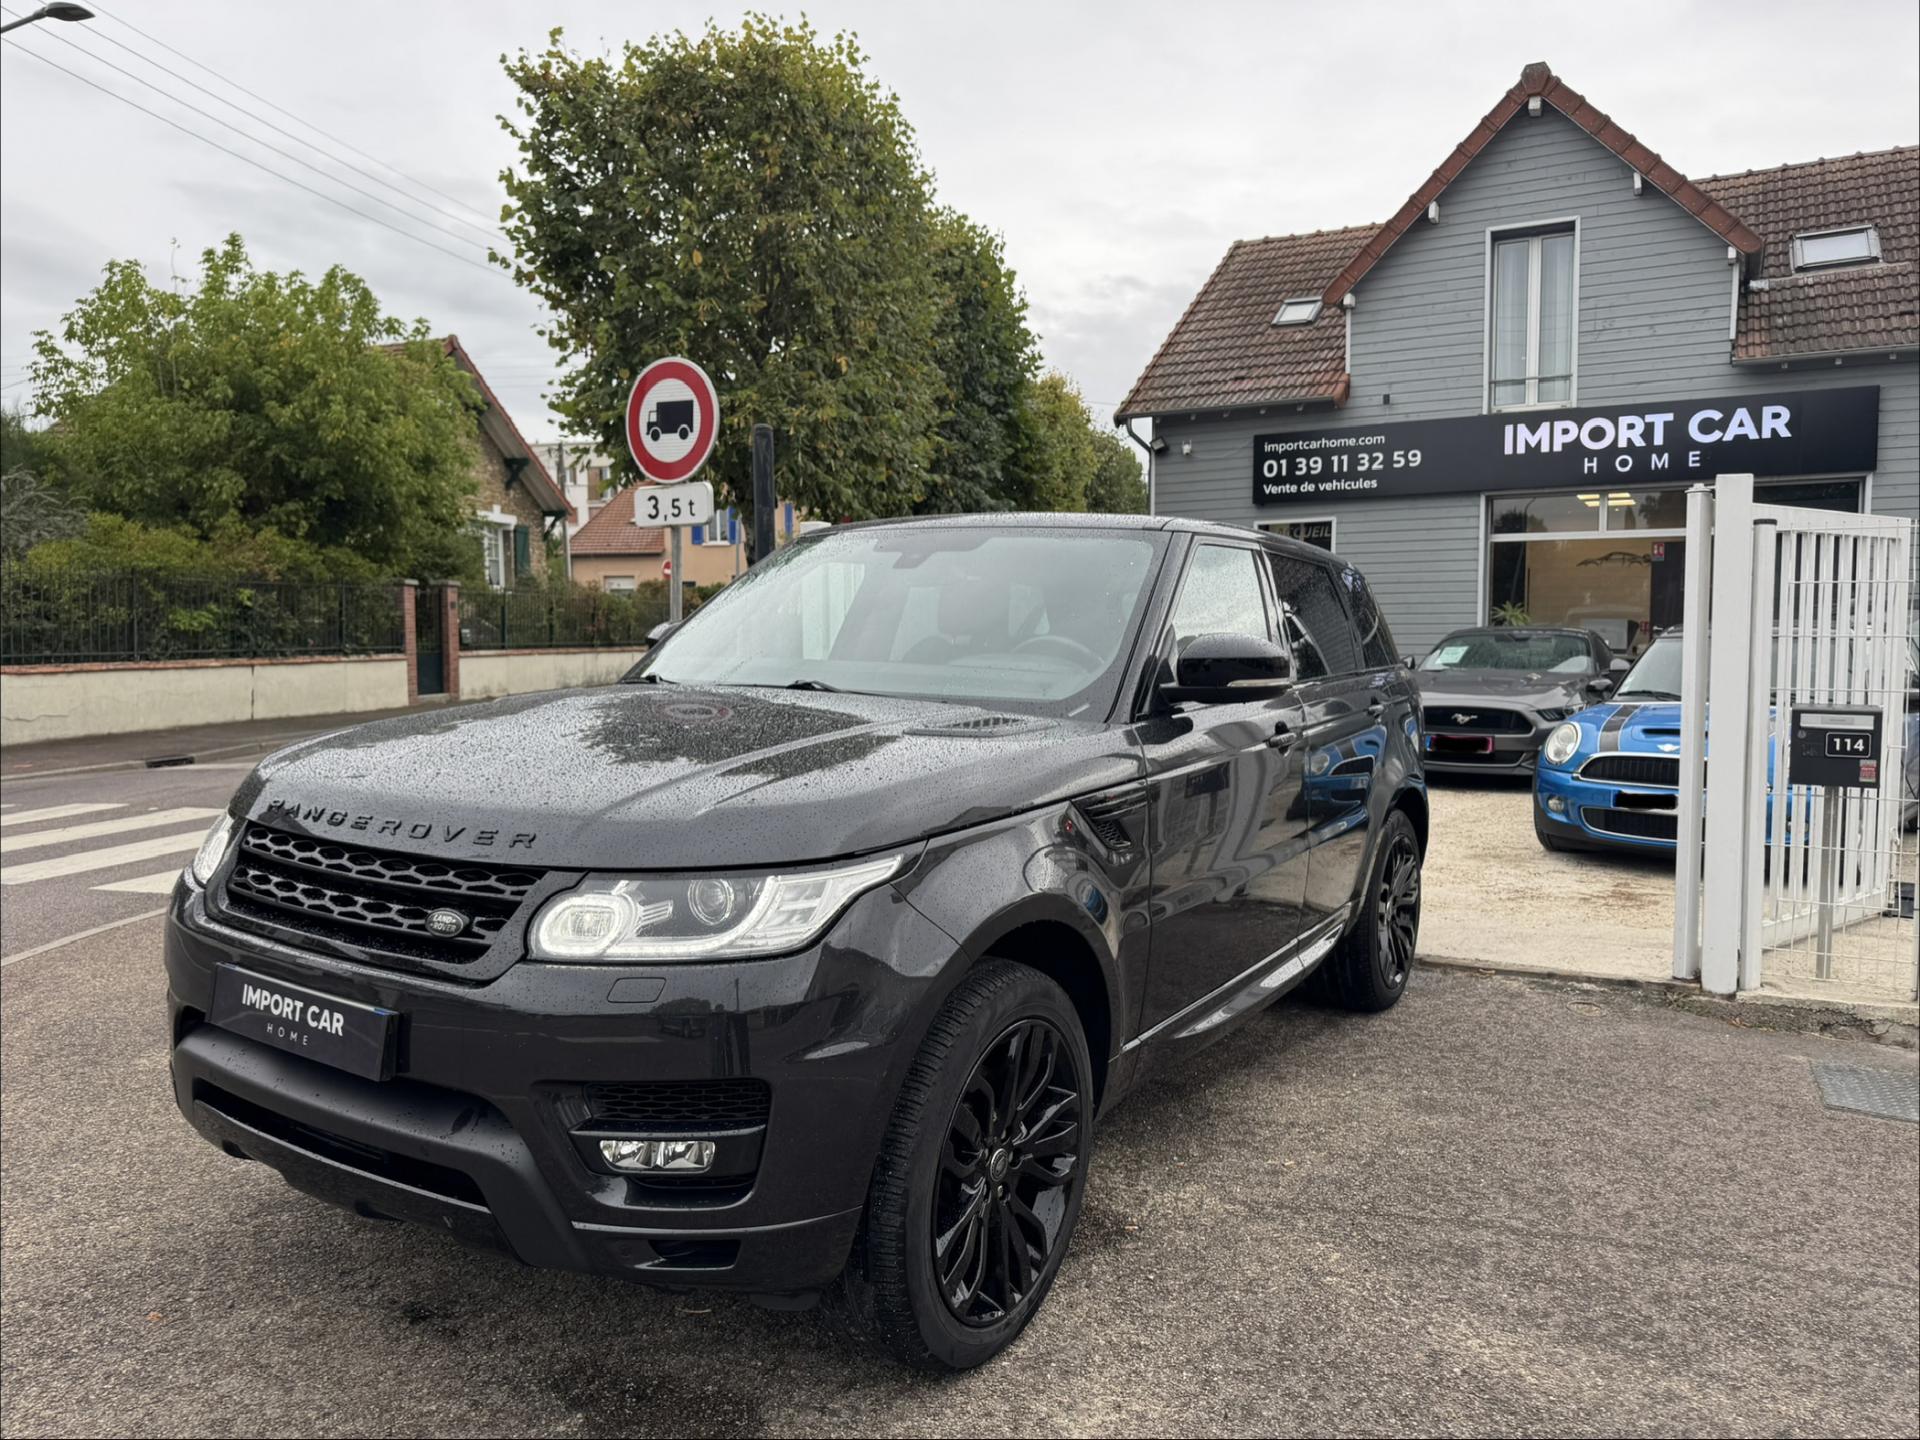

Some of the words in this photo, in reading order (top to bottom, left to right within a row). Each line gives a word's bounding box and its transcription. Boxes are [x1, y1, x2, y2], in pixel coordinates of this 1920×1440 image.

[1504, 412, 1674, 455] IMPORT
[1688, 405, 1792, 443] CAR
[1264, 435, 1385, 453] importcarhome.com
[1263, 459, 1287, 478] 01
[1295, 456, 1322, 476] 39
[1331, 454, 1349, 473] 11
[1357, 452, 1384, 471] 32
[1393, 449, 1422, 468] 59
[1584, 450, 1701, 474] HOME
[1263, 483, 1298, 495] Vente
[1300, 481, 1316, 493] de
[1833, 738, 1864, 752] 114
[433, 914, 453, 923] LAND
[242, 983, 304, 1022] IMPORT
[306, 1005, 345, 1036] CAR
[266, 1022, 309, 1046] HOME
